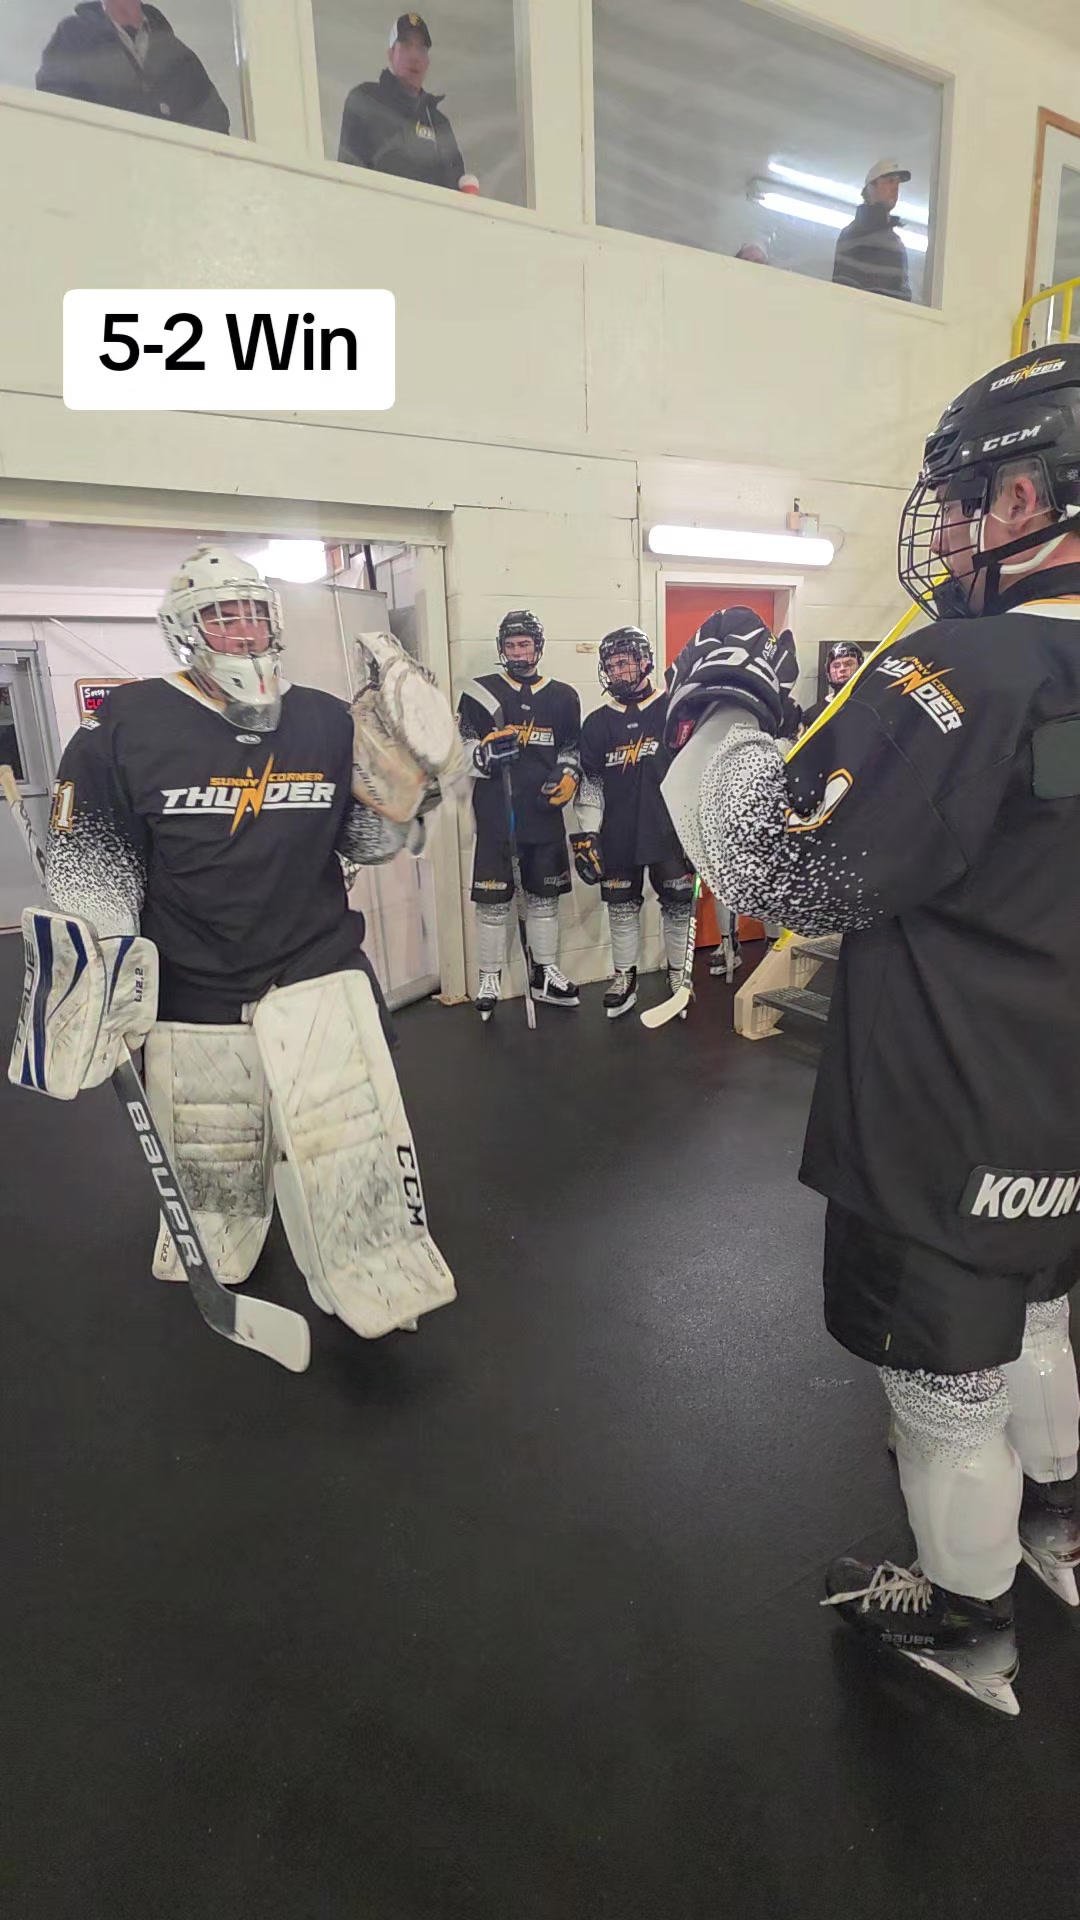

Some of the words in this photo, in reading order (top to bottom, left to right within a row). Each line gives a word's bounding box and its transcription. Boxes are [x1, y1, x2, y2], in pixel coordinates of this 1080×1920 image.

[982, 425, 1042, 452] CCM
[930, 678, 965, 714] CORNER
[160, 772, 337, 820] THUNDER
[209, 777, 259, 787] SUNNY
[268, 772, 325, 782] CORNER
[126, 1101, 204, 1269] BAUER
[396, 1144, 425, 1227] CCM
[970, 1172, 1080, 1219] KOUN
[880, 1632, 935, 1646] BAUER
